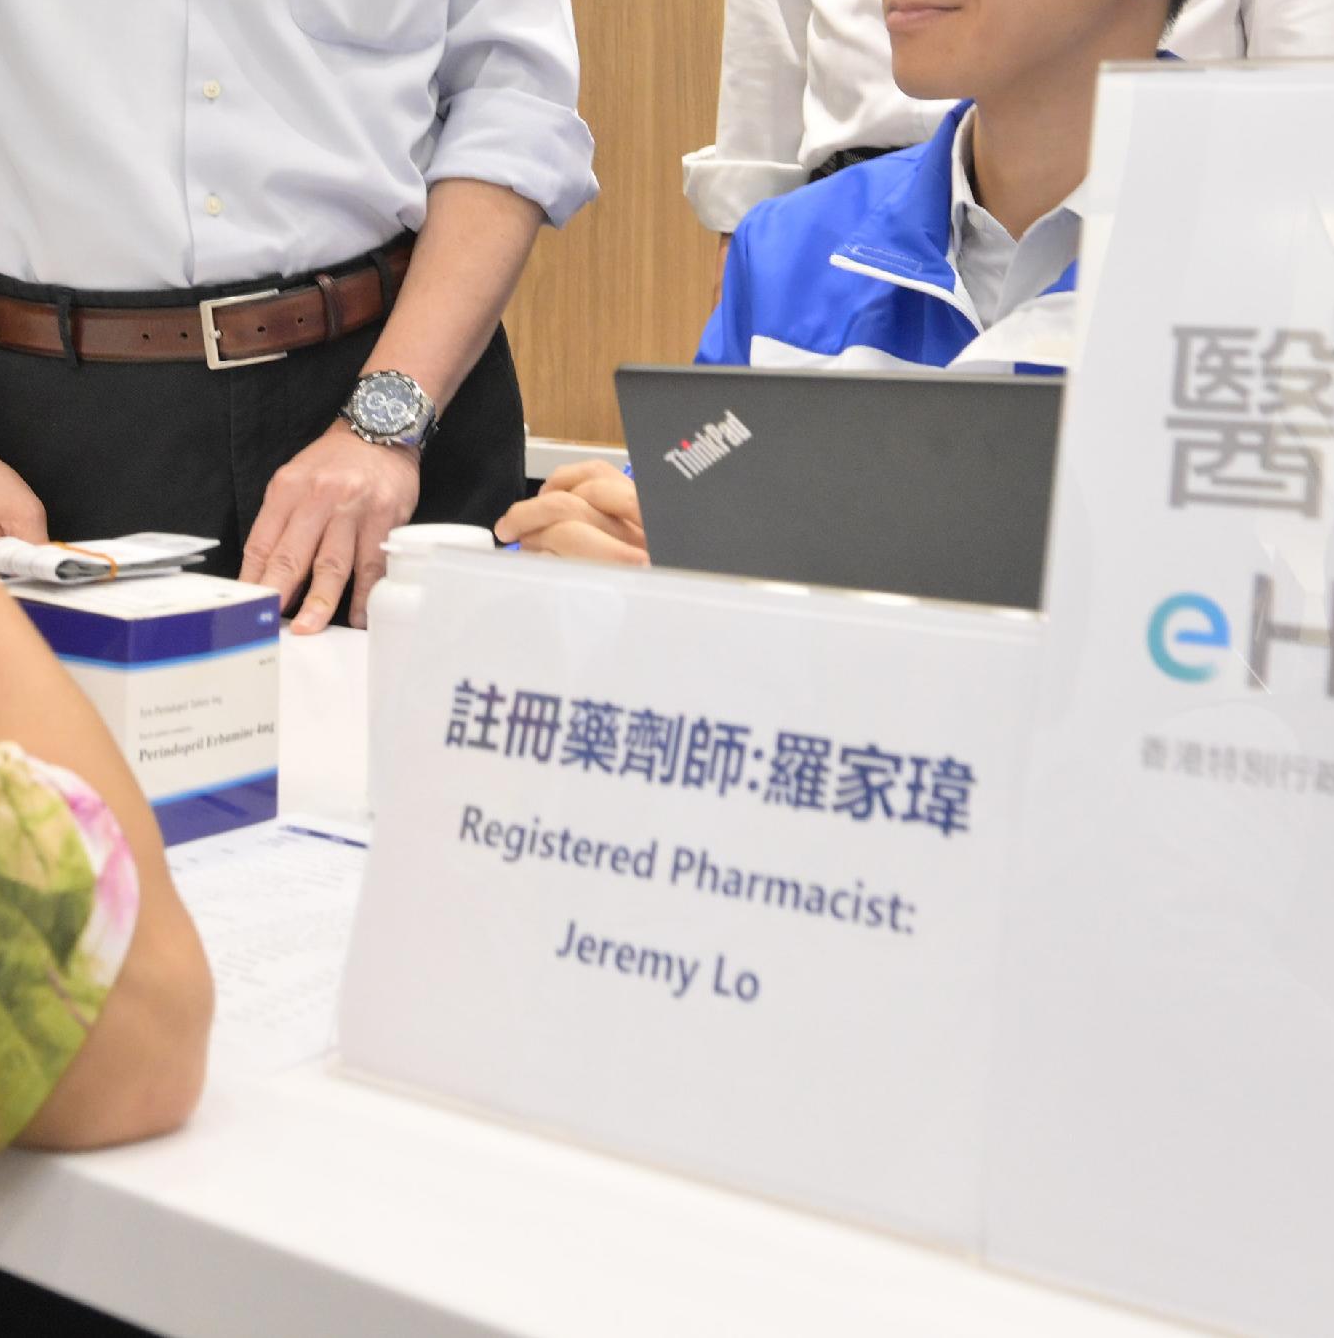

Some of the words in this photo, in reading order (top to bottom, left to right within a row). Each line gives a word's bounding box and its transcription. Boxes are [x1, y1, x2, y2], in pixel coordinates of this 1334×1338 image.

[663, 409, 753, 481] ThinkPad
[459, 805, 658, 879] Registered
[669, 846, 916, 935] Pharmacist:
[556, 920, 699, 998] Jeremy
[713, 956, 761, 1003] Lo
